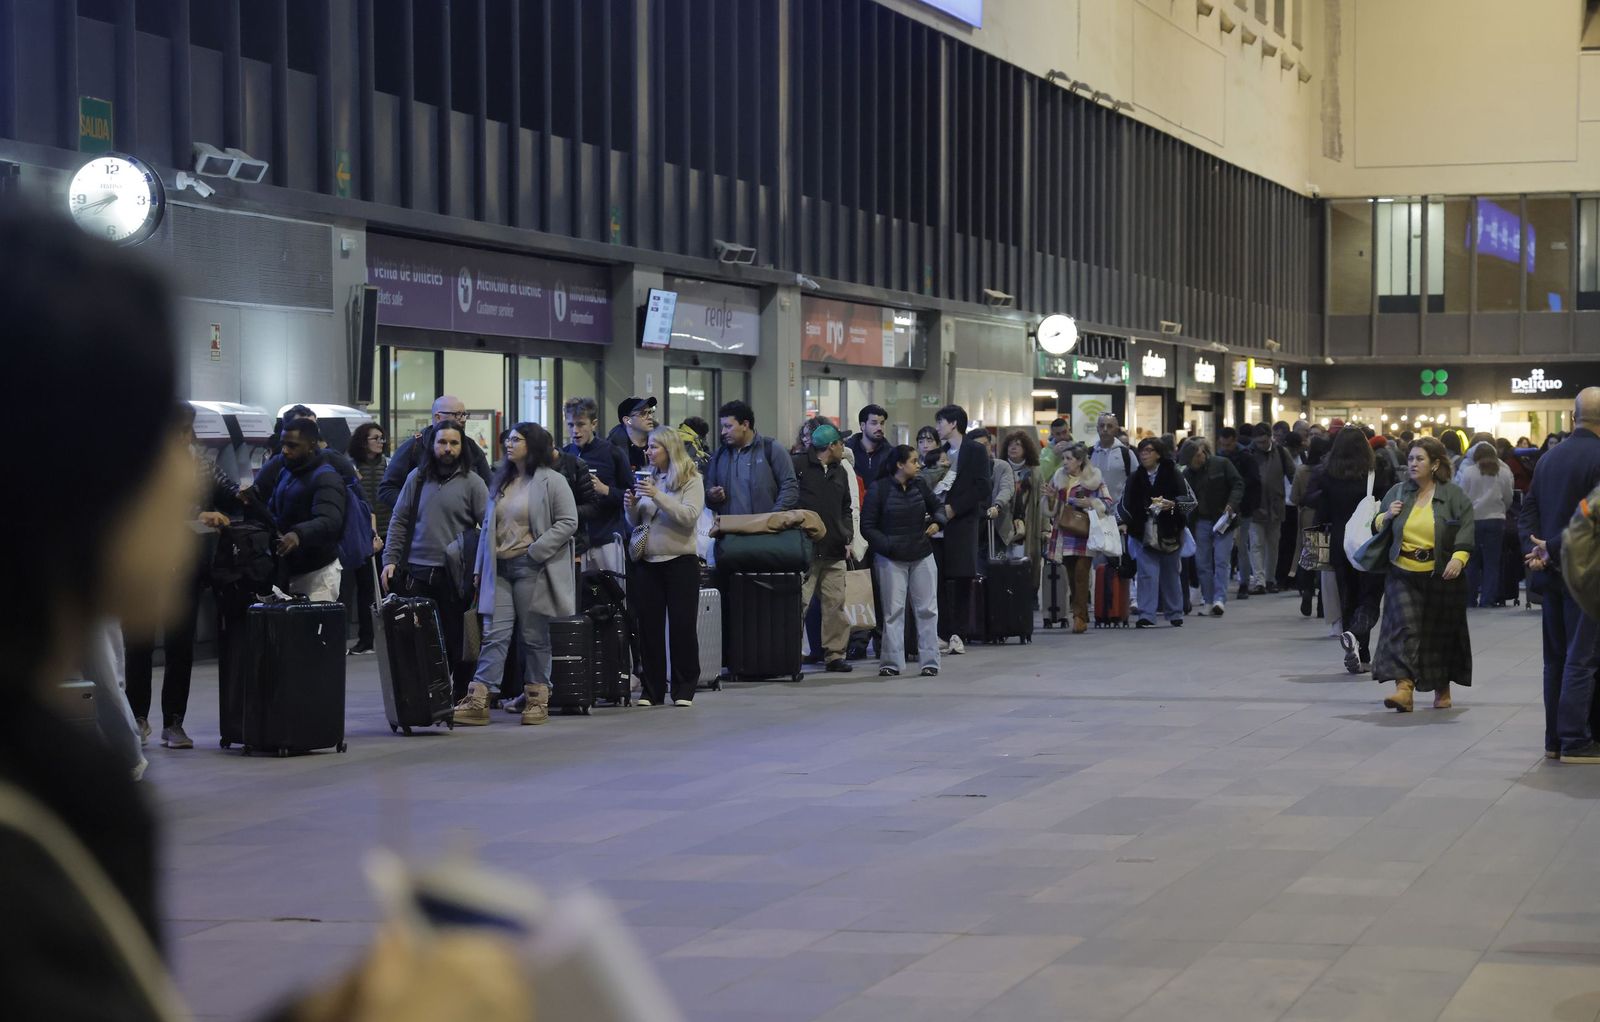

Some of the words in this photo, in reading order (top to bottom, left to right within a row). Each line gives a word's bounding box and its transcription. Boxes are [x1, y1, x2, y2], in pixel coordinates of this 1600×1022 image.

[80, 114, 110, 140] SALIDA
[105, 164, 119, 175] 12
[77, 193, 87, 205] 9
[137, 195, 146, 206] 3
[106, 224, 116, 237] 6
[705, 298, 733, 339] renfe
[1511, 378, 1562, 392] Deliquo
